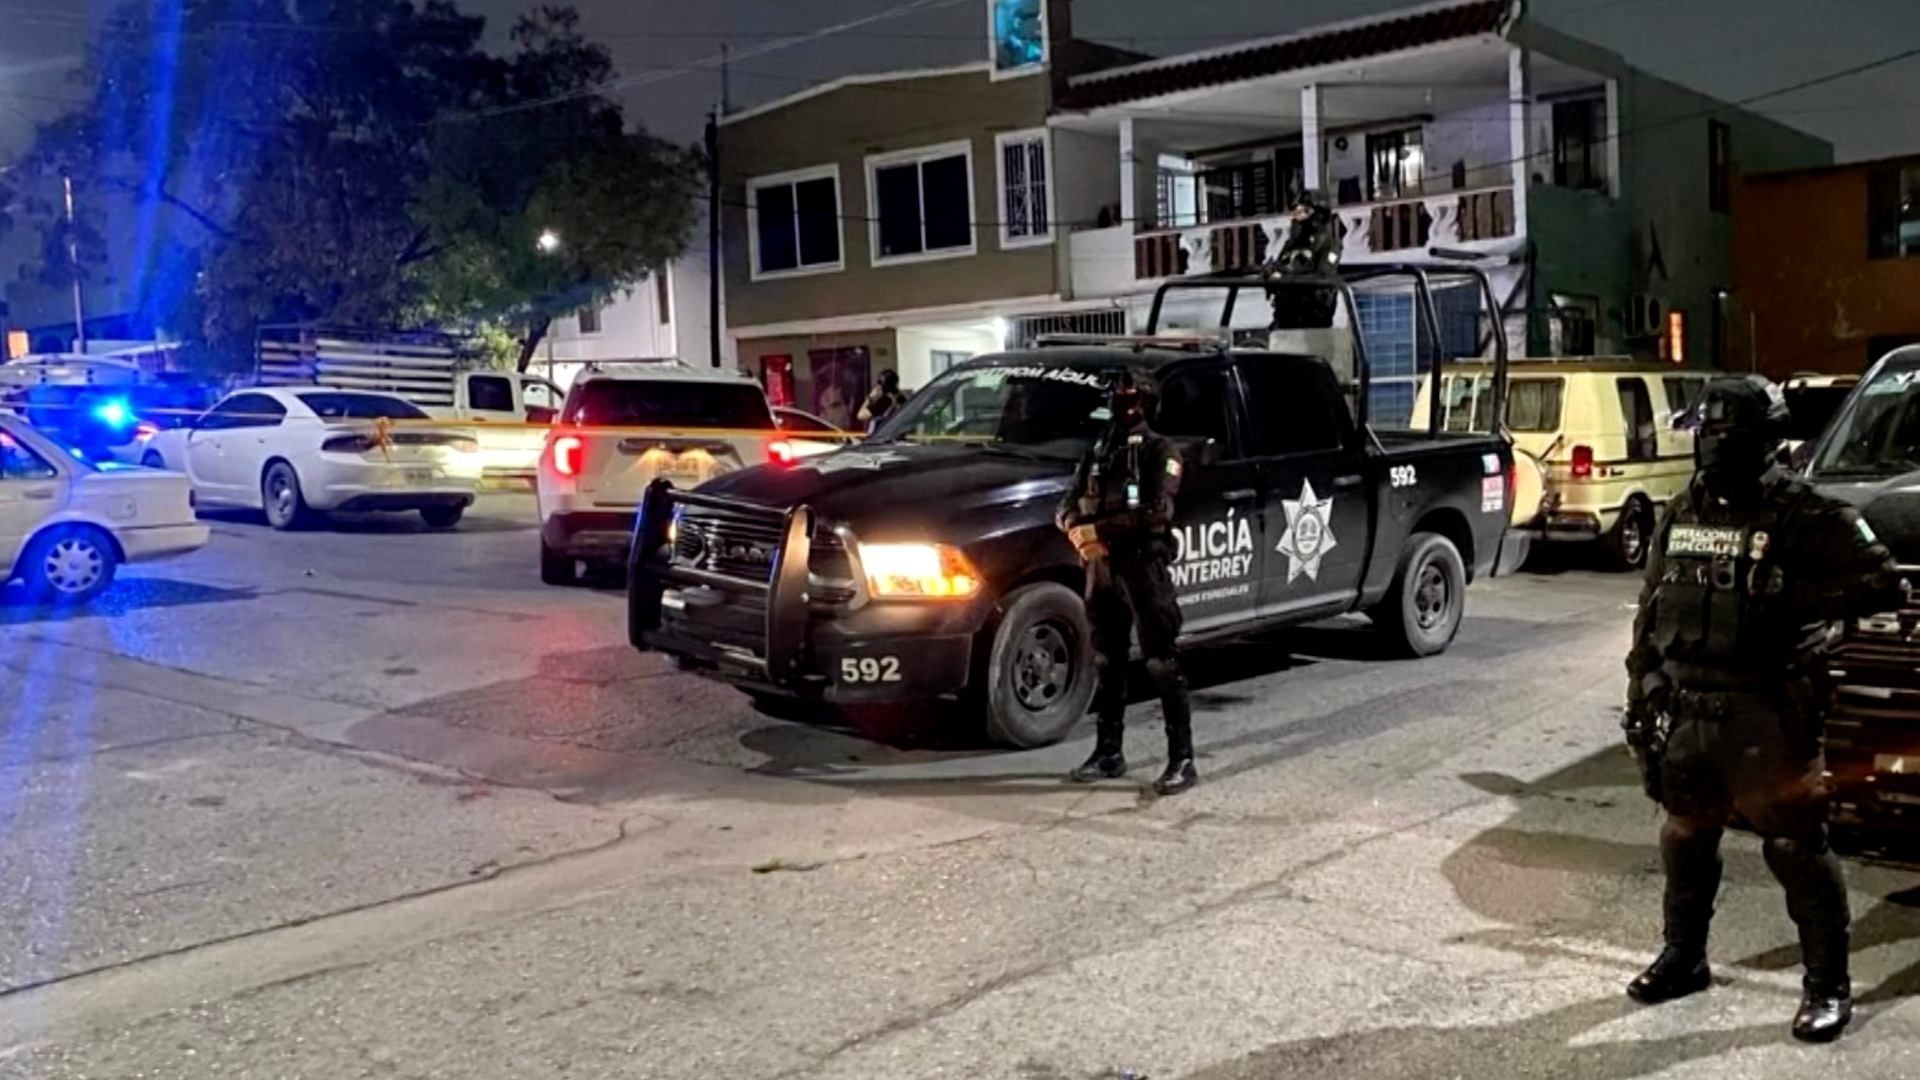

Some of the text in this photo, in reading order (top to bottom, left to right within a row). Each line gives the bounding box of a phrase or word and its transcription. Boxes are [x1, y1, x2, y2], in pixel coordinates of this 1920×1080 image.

[1390, 465, 1418, 488] 592
[1170, 507, 1253, 564] OLICÍA
[841, 655, 902, 683] 592
